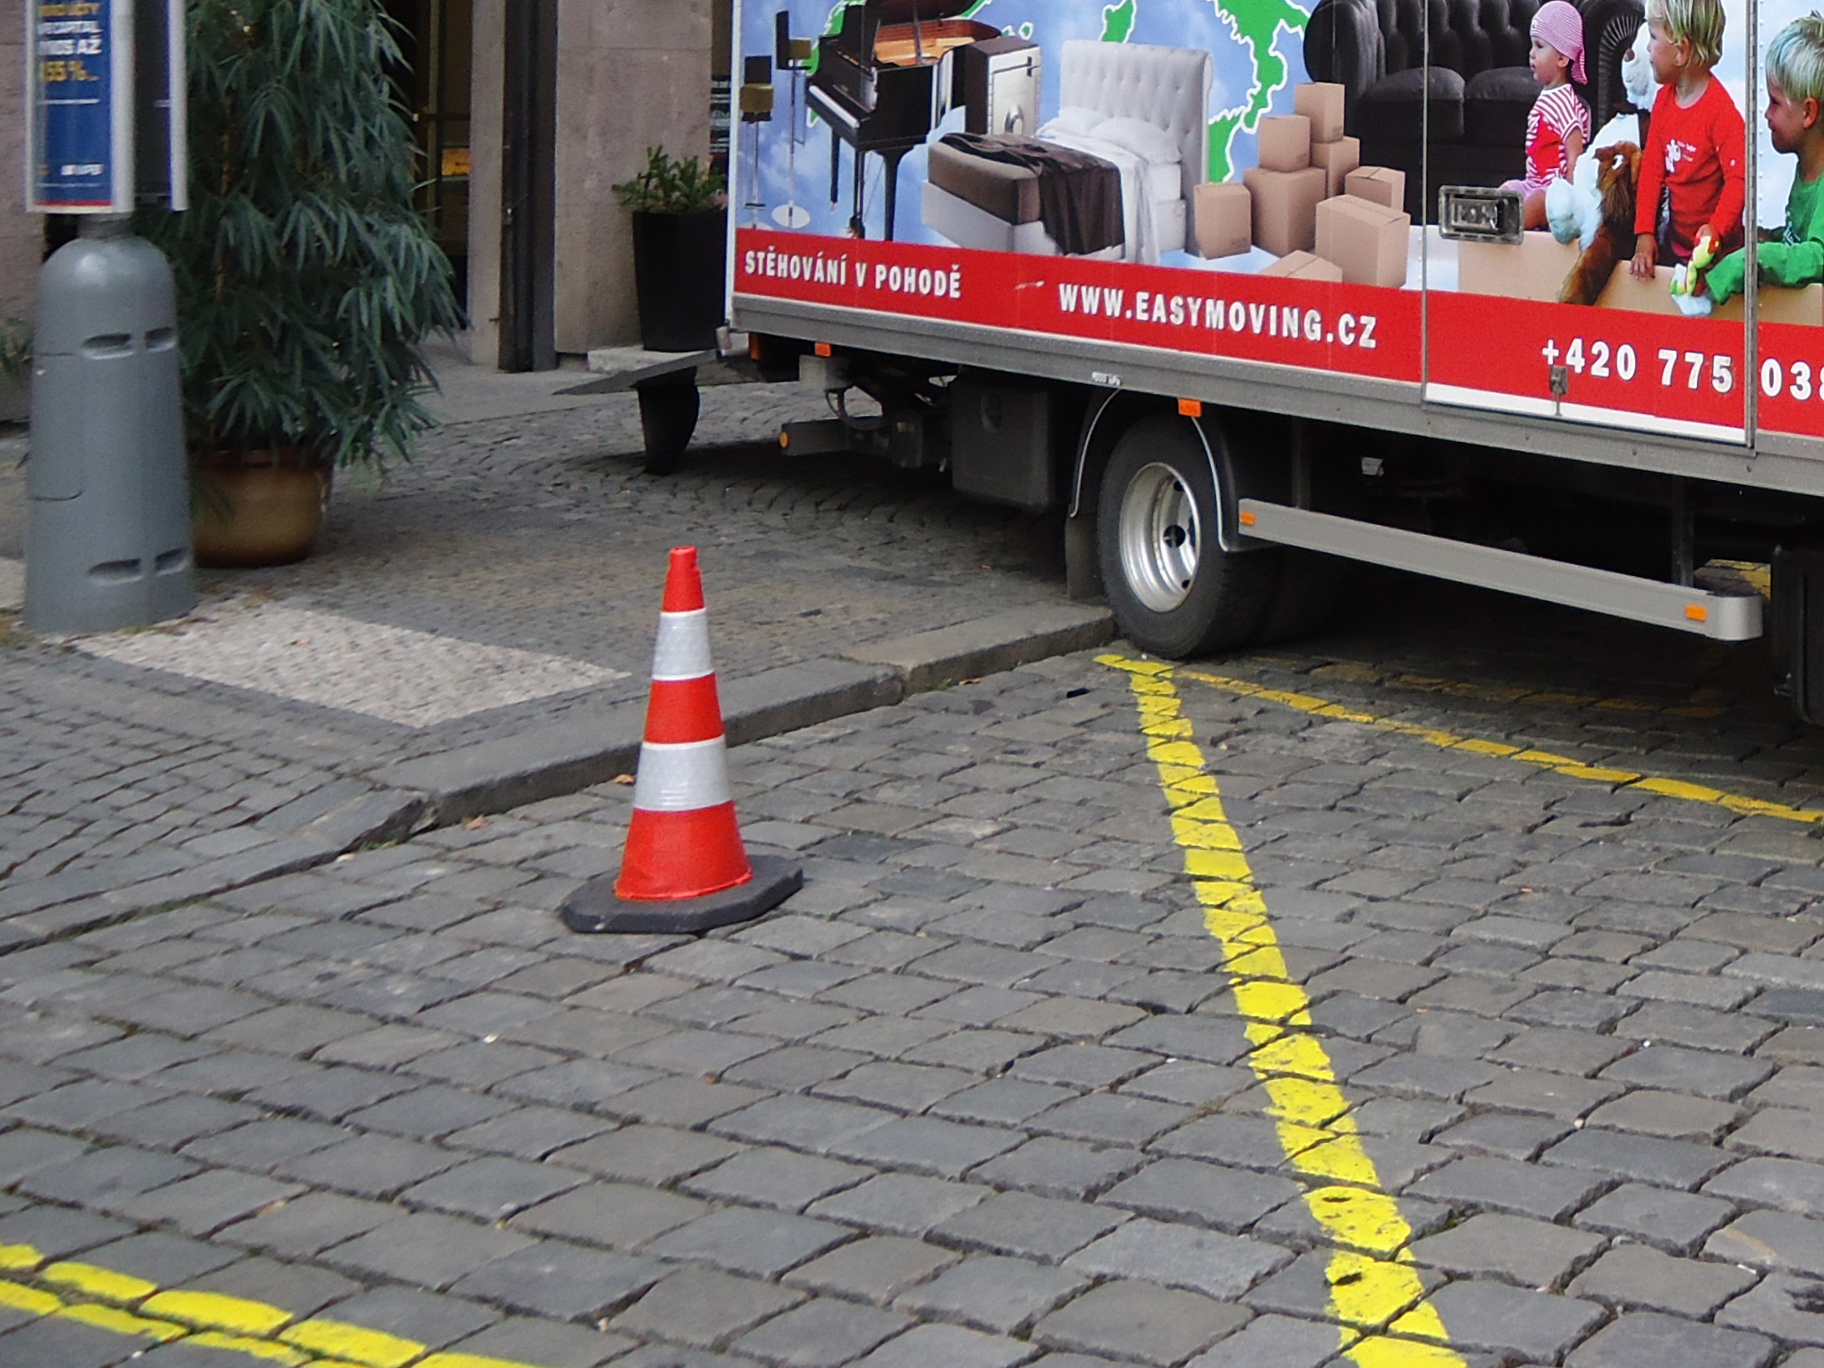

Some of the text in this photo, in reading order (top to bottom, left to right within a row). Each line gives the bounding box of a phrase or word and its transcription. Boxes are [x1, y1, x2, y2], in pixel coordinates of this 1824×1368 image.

[745, 245, 962, 299] STĚHOVÁNÍ V POHODĚ
[1058, 283, 1378, 348] WWW.EASYMOVING.CZ
[1541, 337, 1637, 382] +420
[1658, 348, 1735, 395] 775
